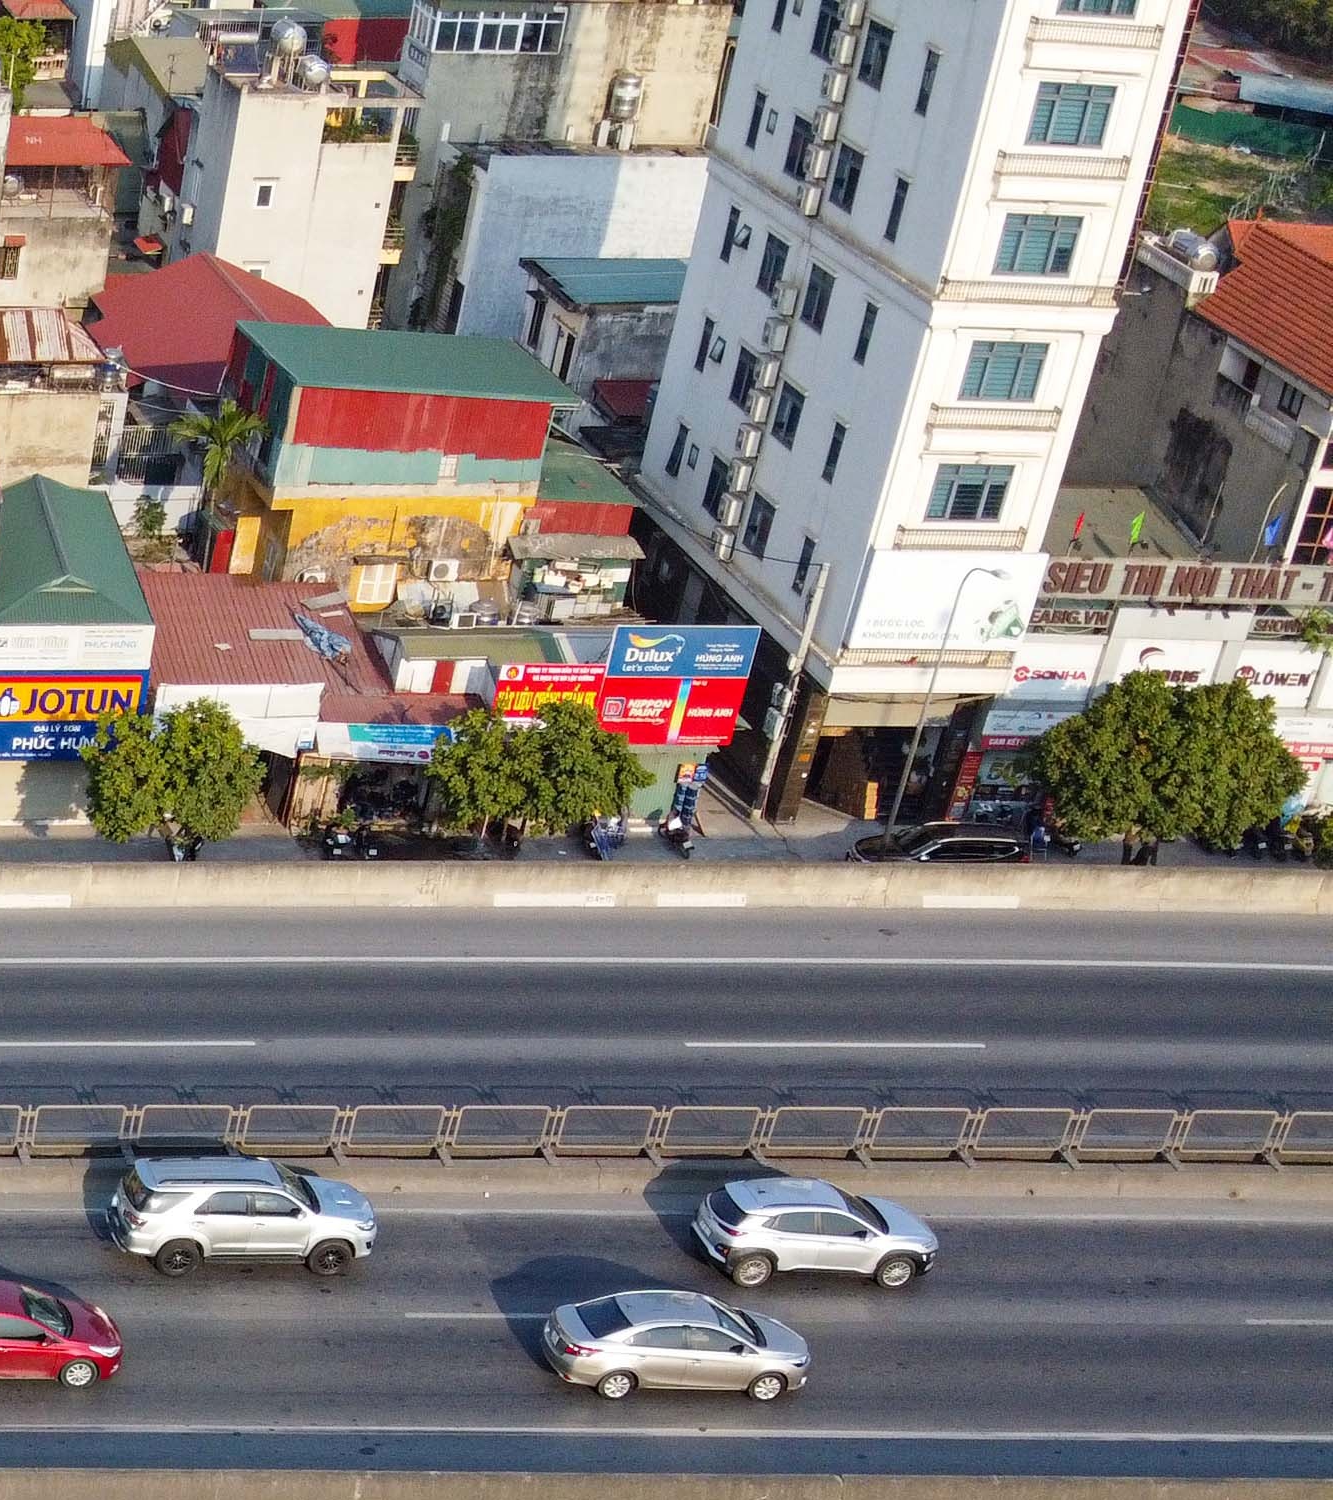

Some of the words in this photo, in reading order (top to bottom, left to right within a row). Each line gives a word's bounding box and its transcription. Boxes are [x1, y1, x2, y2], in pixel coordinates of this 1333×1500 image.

[1030, 609, 1110, 625] EABIG.VN
[624, 647, 674, 664] Dulux
[694, 651, 723, 664] HÙNG
[722, 654, 745, 664] ANH
[622, 663, 644, 673] Let's
[644, 663, 672, 673] colour
[23, 688, 133, 715] JOTUN
[627, 698, 673, 709] NIPPON
[628, 708, 665, 718] PAINT
[686, 707, 713, 718] HÙNG
[712, 708, 734, 718] ANH
[12, 731, 55, 750] PHÚC
